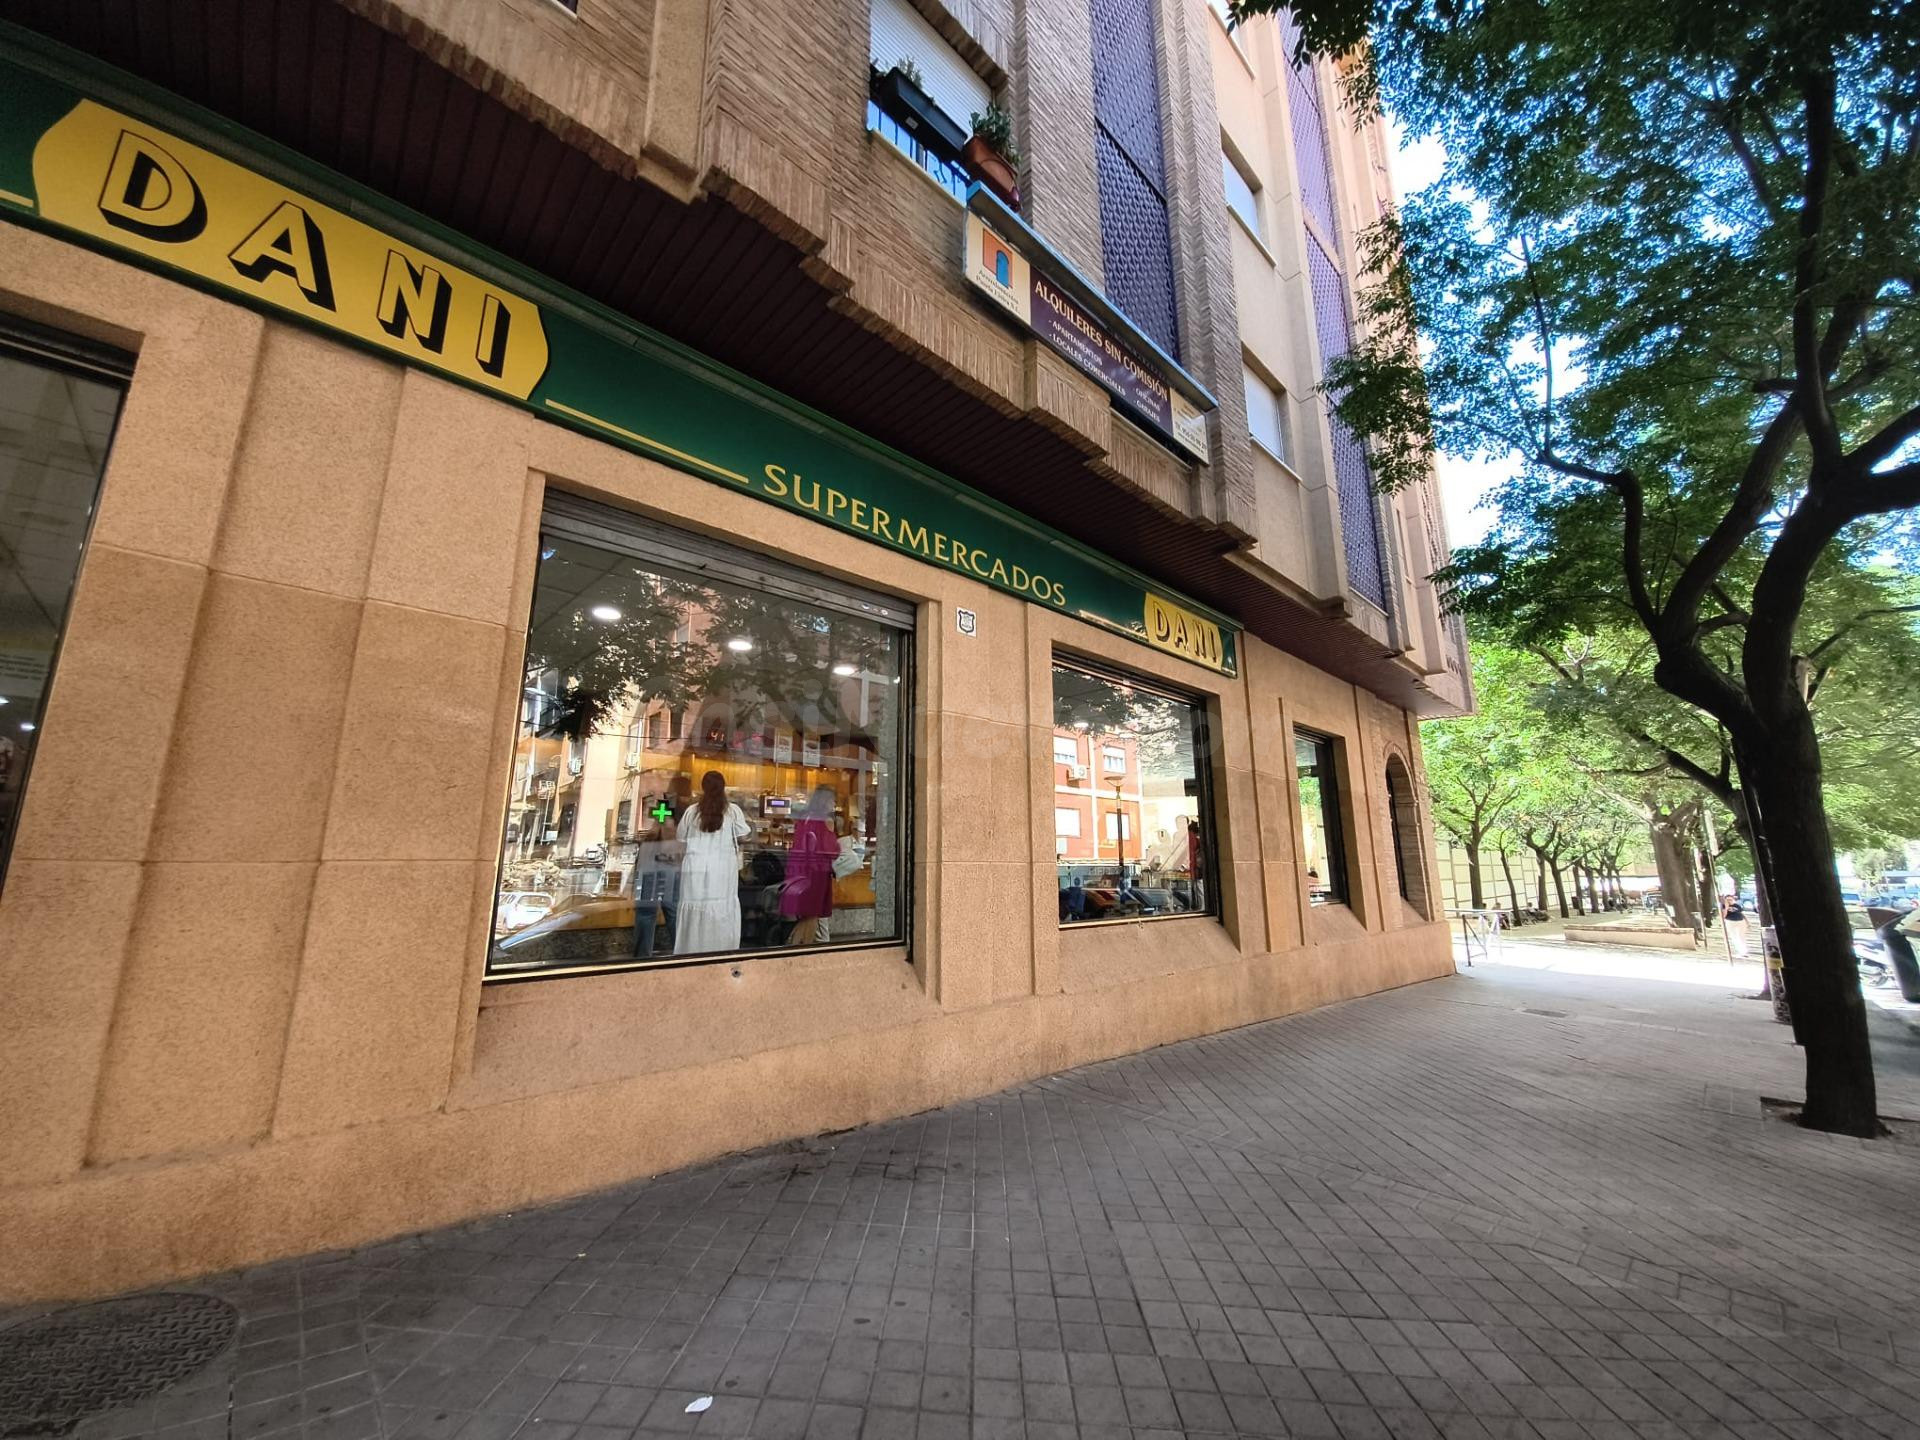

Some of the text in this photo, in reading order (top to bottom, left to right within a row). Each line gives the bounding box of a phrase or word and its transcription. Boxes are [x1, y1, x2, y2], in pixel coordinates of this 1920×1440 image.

[98, 129, 511, 378] DANI
[1035, 281, 1167, 401] ALQUILERES SIN COMISIÓN
[1052, 320, 1102, 366] APARTAMENTOS
[1053, 333, 1125, 396] LOCALES COMERCIALES
[1135, 388, 1160, 411] OFICINAS
[1136, 400, 1160, 423] GARAJES
[763, 464, 1067, 606] SUPERMERCADOS
[1153, 602, 1217, 663] DANI
